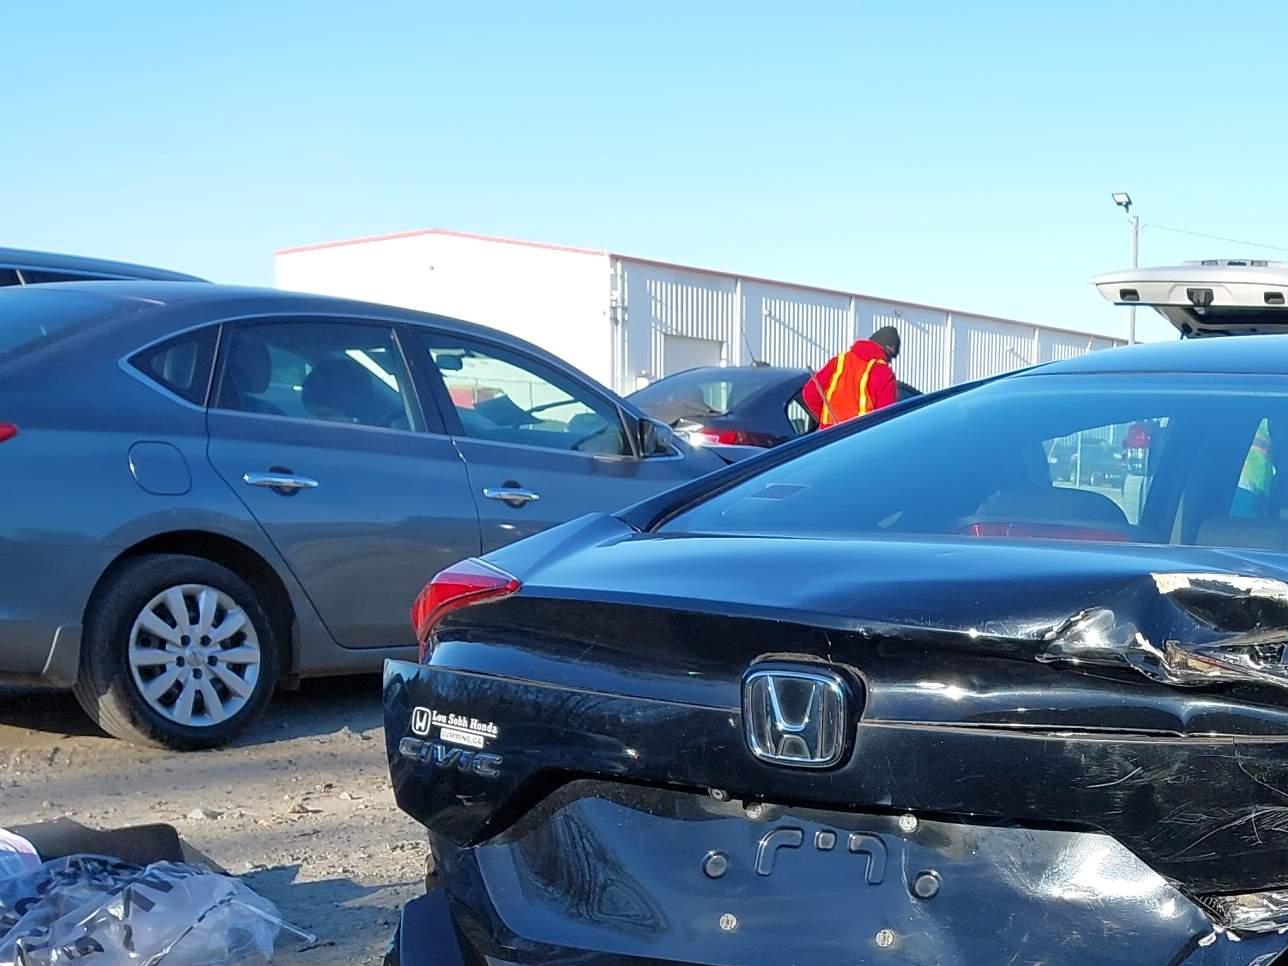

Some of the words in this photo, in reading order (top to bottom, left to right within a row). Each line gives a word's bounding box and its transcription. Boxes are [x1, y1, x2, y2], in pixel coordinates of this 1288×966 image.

[431, 710, 447, 723] Lou
[447, 713, 468, 729] Sobh
[469, 718, 498, 735] Honda
[399, 736, 503, 777] CIVIC
